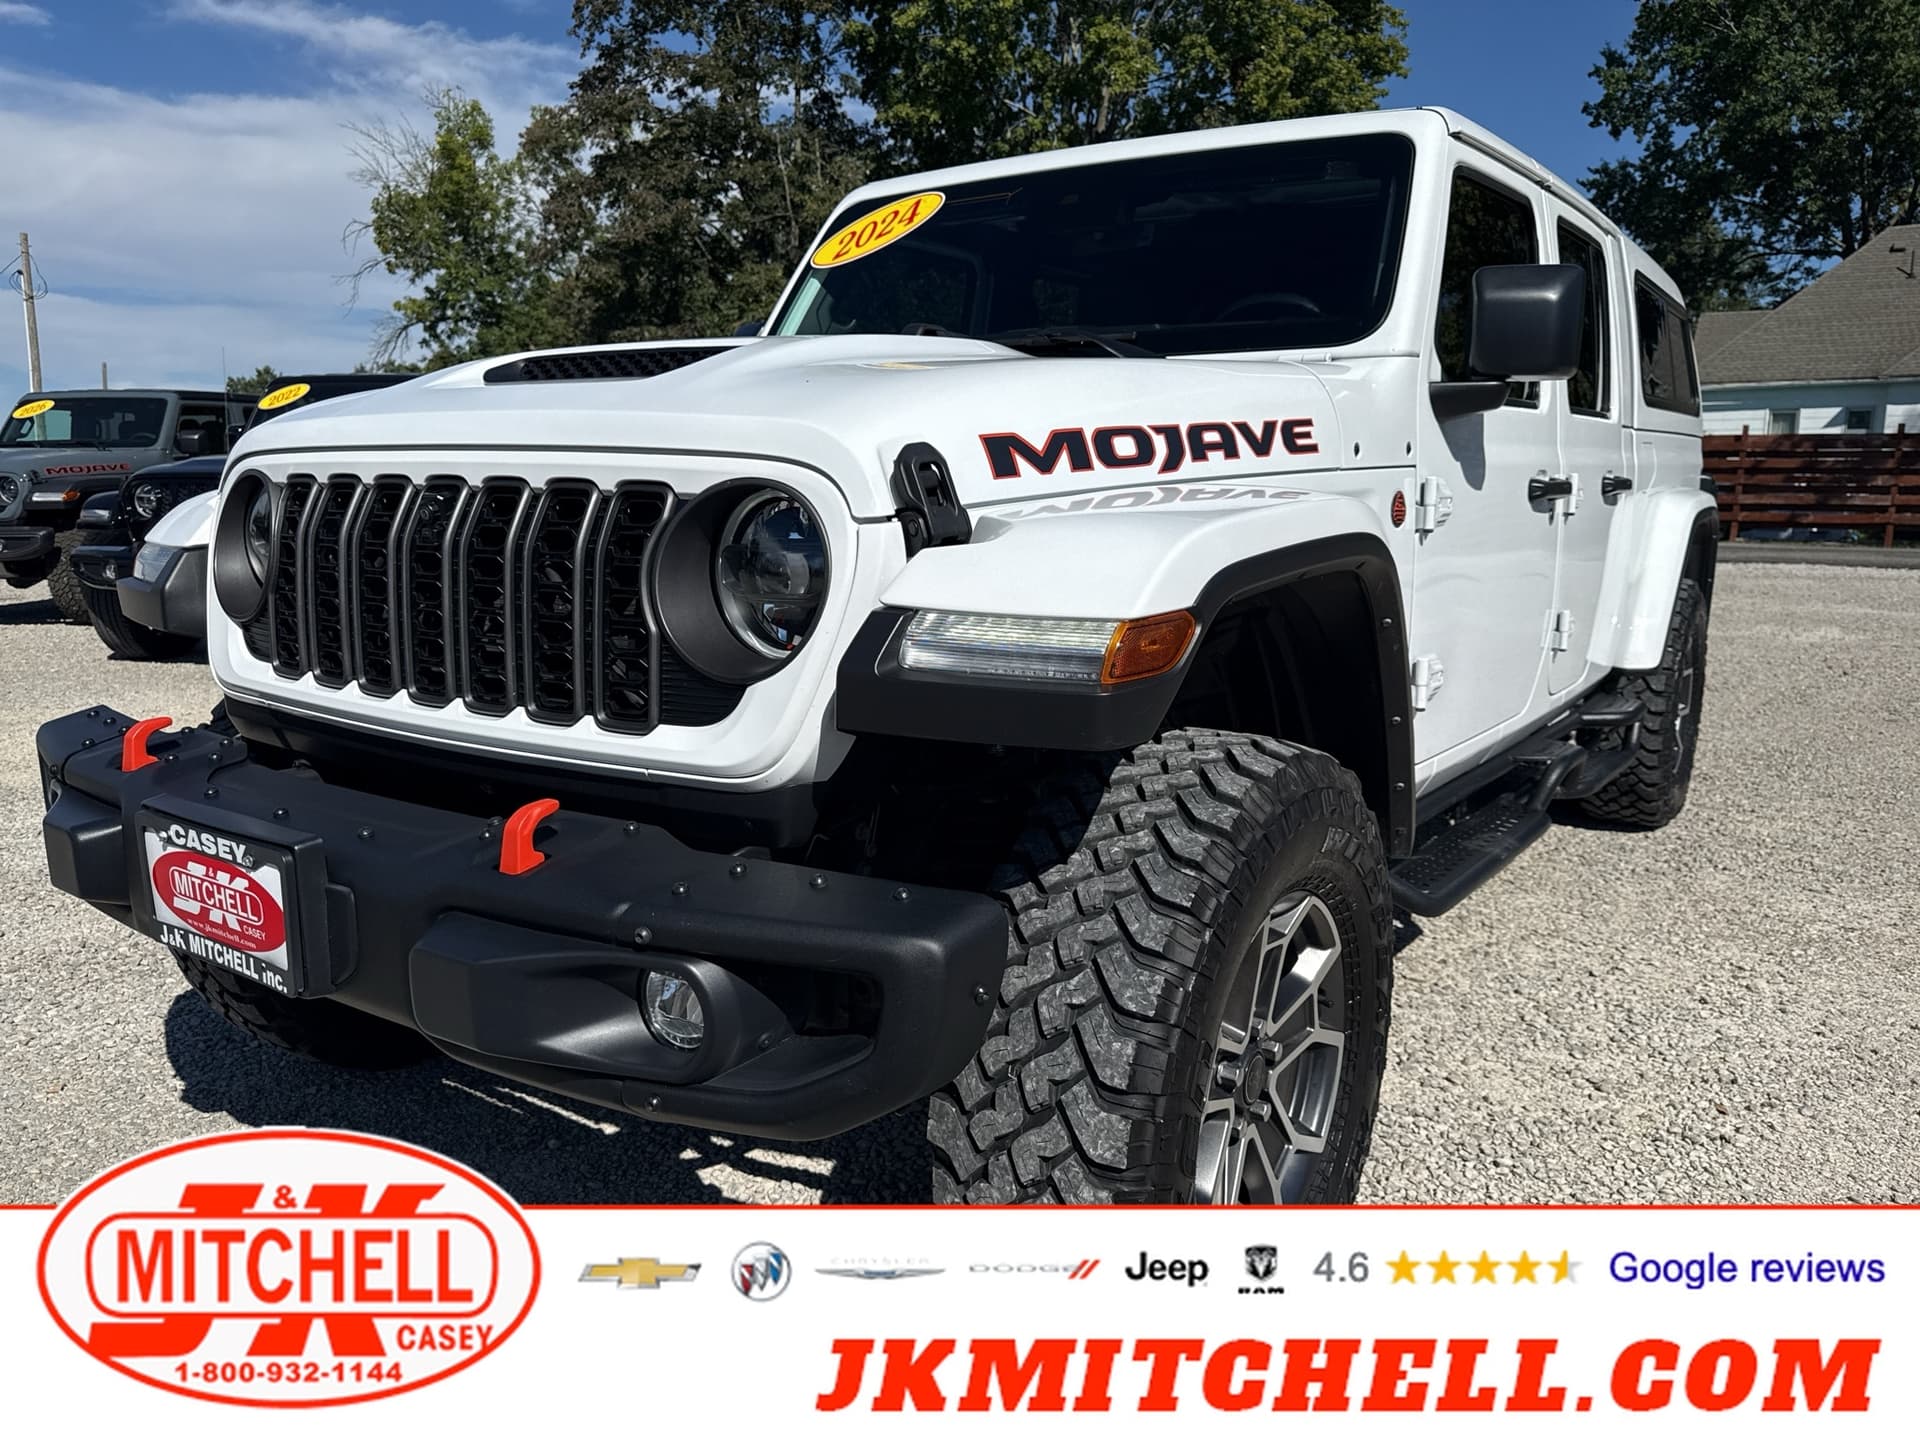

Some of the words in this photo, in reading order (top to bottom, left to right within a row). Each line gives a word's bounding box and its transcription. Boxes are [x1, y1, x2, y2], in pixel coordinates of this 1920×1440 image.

[831, 198, 923, 261] 2024
[267, 387, 301, 407] 2022
[44, 463, 130, 476] MOJAVE
[978, 418, 1320, 480] MOJAVE
[168, 824, 246, 864] CASEY
[173, 870, 259, 922] MITCHELL
[243, 925, 266, 941] CASEY
[188, 936, 260, 980] MITCHELL
[261, 962, 288, 994] inc.
